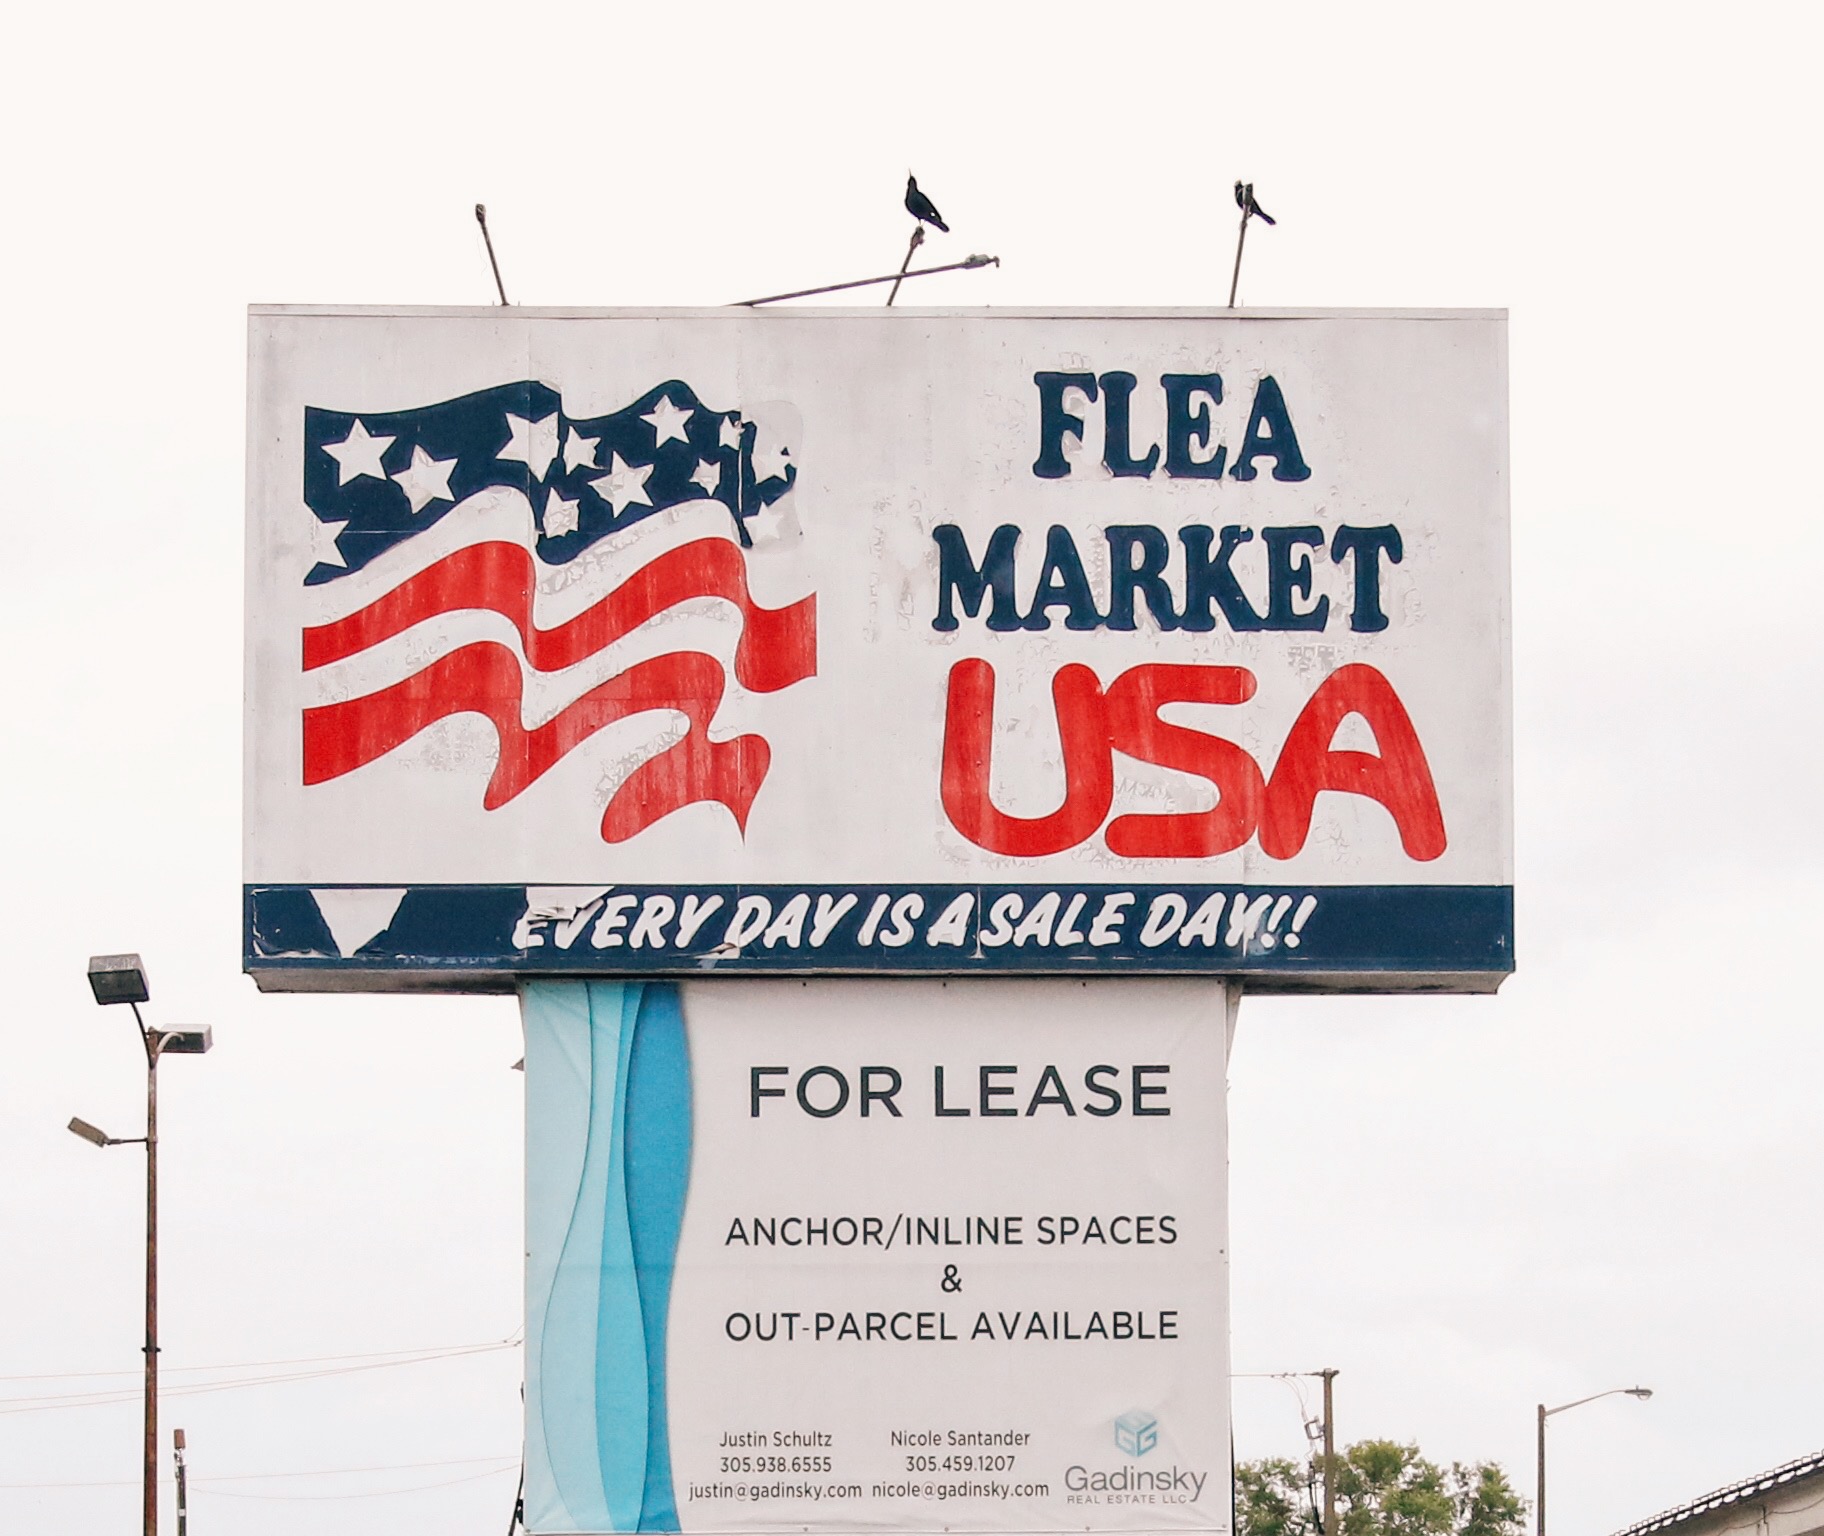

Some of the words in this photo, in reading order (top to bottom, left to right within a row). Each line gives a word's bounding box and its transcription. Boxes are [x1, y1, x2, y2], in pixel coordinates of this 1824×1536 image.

[1032, 370, 1312, 483] FLEA
[931, 523, 1403, 634] MARKET
[940, 656, 1448, 862] USA
[511, 891, 724, 950] EVERY
[722, 893, 858, 951] DAY
[857, 893, 925, 949] IS
[926, 891, 976, 948] A
[979, 891, 1135, 948] SALE
[1139, 892, 1319, 949] DAY!!
[750, 1065, 903, 1119] FOR
[934, 1064, 1171, 1118] LEASE
[724, 1213, 1024, 1251] ANCHOR/INLINE
[1037, 1215, 1178, 1245] SPACES
[940, 1263, 963, 1294] &
[725, 1311, 958, 1342] OUT-PARCEL
[970, 1310, 1179, 1341] AVAILABLE
[719, 1430, 768, 1448] Justin
[773, 1430, 833, 1448] Schultz
[891, 1429, 942, 1447] Nicole
[947, 1429, 1031, 1447] Santander
[720, 1456, 832, 1473] 305.938.6555
[905, 1455, 1016, 1472] 305.459.1207
[689, 1481, 862, 1502] justin@gadinsky.com
[872, 1480, 1049, 1501] nicole@gadinsky.com
[1064, 1465, 1208, 1503] Gadinsky
[1066, 1494, 1101, 1505] REAL
[1106, 1494, 1156, 1505] ESTATE
[1162, 1494, 1188, 1505] LLC
